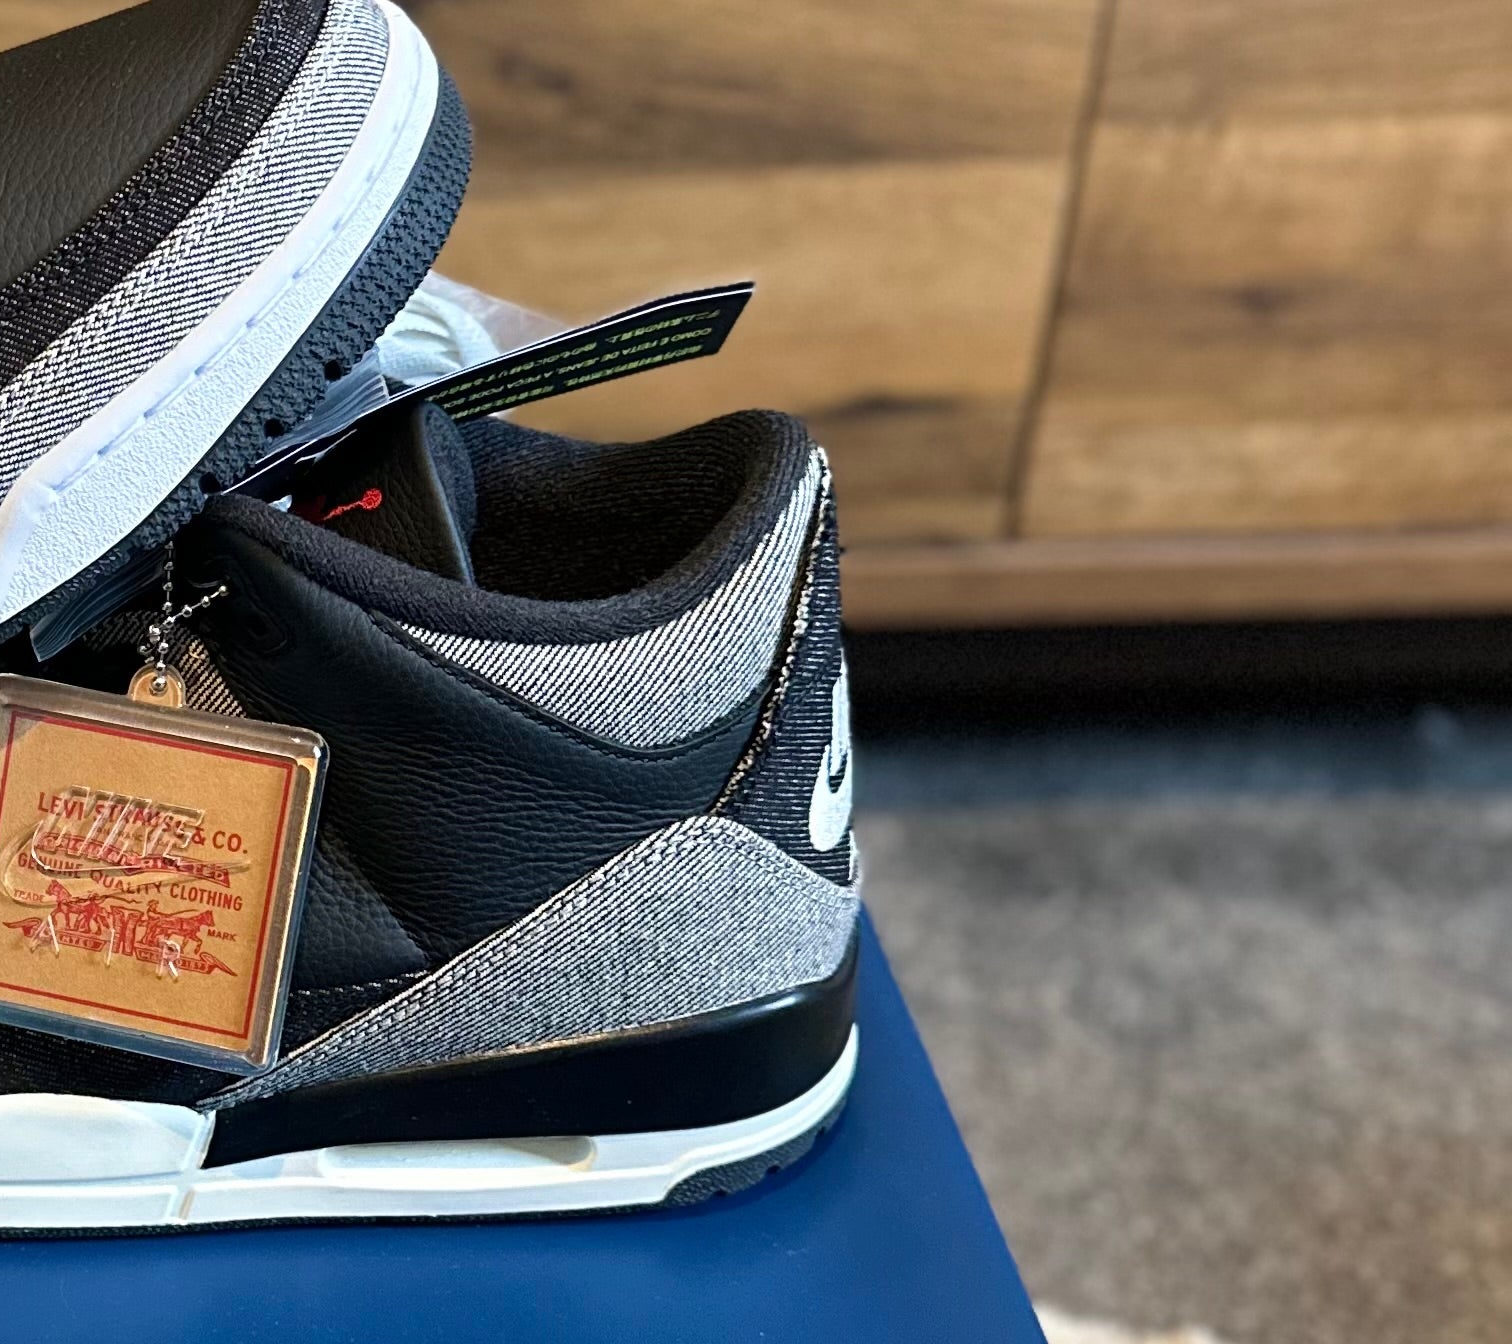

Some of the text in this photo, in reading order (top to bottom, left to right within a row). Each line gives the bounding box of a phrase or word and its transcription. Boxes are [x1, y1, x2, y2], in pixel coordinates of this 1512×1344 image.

[671, 327, 712, 342] COMO
[622, 340, 658, 355] FEITA
[600, 351, 620, 362] DE
[38, 792, 85, 821] LEVI
[191, 826, 206, 846] &
[212, 829, 249, 855] CO.
[14, 889, 46, 904] TRADE
[90, 869, 162, 896] QUALITY
[170, 883, 243, 912] CLOTHING
[207, 929, 238, 943] MARK
